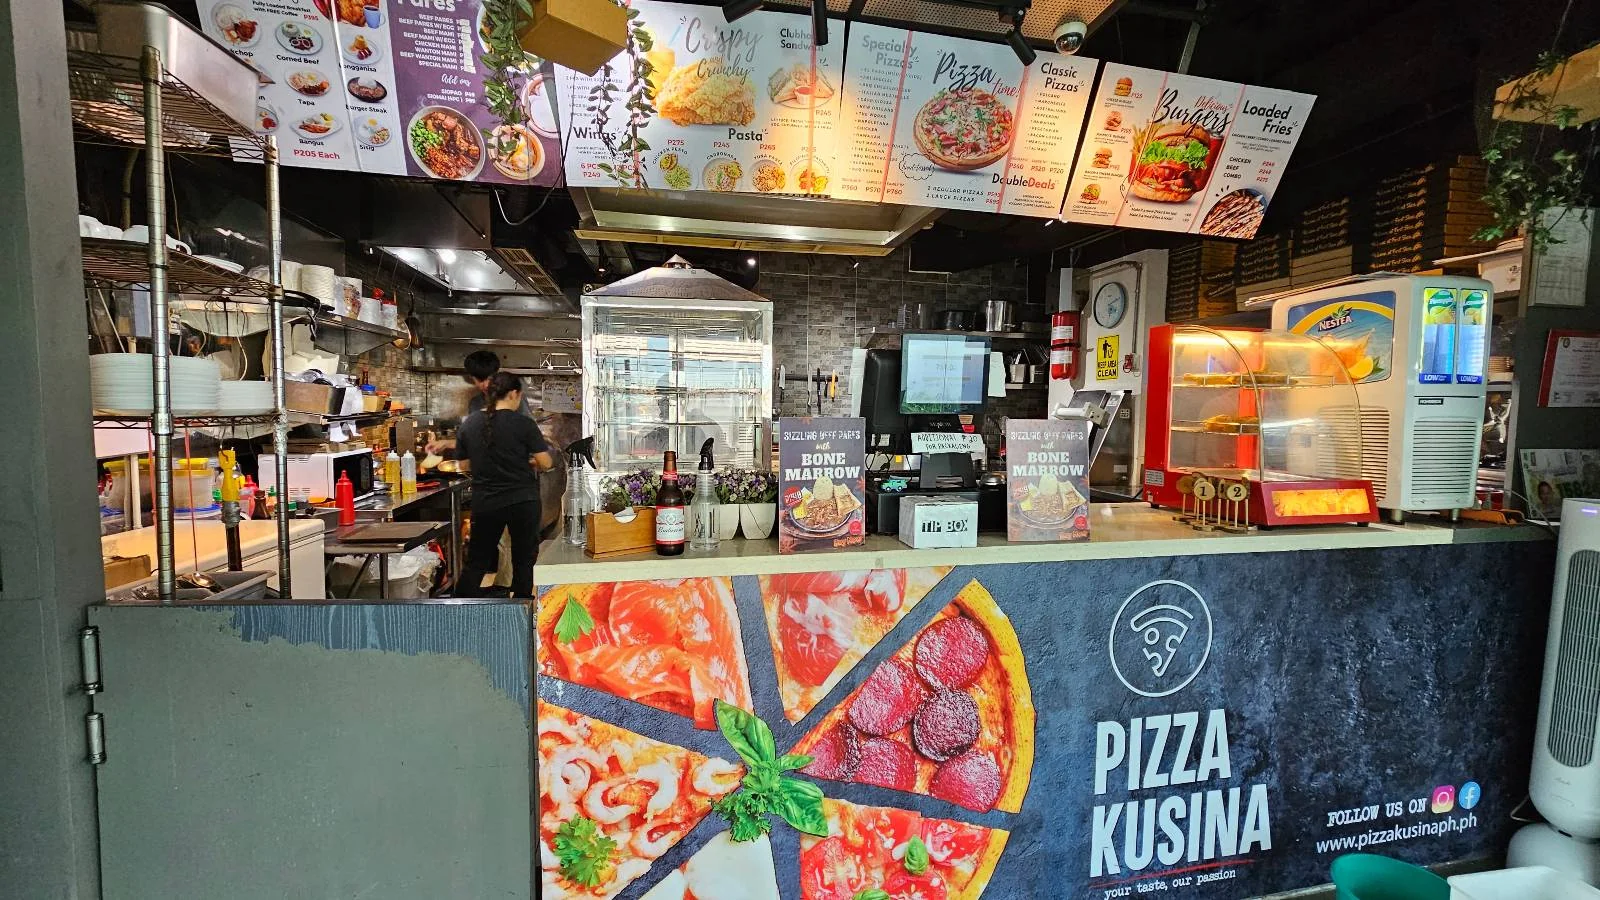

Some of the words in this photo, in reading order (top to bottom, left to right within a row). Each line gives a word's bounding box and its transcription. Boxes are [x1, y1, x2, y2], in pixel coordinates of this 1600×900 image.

[434, 16, 454, 24] PARES
[414, 40, 440, 48] CHICKEN
[440, 43, 457, 51] MAMI
[686, 16, 763, 62] Crispy
[414, 47, 441, 55] WANTON
[862, 35, 918, 57] Specialy
[276, 54, 302, 63] Corned
[303, 56, 319, 65] Beef
[419, 60, 442, 68] SPECIAL
[697, 53, 751, 84] Crunchy
[932, 51, 997, 93] Pizza
[1040, 62, 1078, 79] Classic
[441, 73, 459, 85] Add
[1045, 77, 1079, 93] Pizzas
[298, 98, 315, 106] Tapa
[1153, 88, 1231, 138] Burgers
[1242, 100, 1293, 120] Loaded
[1262, 119, 1293, 136] Fries
[728, 128, 763, 142] Pasta
[293, 149, 317, 158] P205
[318, 150, 341, 160] Each
[1229, 156, 1252, 164] CHICKEN
[1319, 315, 1352, 331] NESTEA
[1107, 360, 1117, 368] AREA
[1097, 369, 1117, 378] CLEAN
[784, 431, 817, 440] SIZZLING
[1011, 431, 1041, 440] SIZZLING
[802, 453, 845, 466] BONE
[1028, 452, 1069, 463] BONE
[785, 466, 860, 481] MARROW
[1013, 464, 1084, 477] MARROW
[1200, 486, 1207, 496] 1
[1233, 486, 1242, 497] 2
[922, 520, 942, 532] TIP
[946, 519, 968, 533] BOX
[1094, 708, 1232, 796] PIZZA
[1327, 804, 1380, 827] FOLLOW
[1385, 801, 1403, 818] US
[1408, 798, 1428, 814] ON
[1089, 783, 1272, 878] KUSINA
[1316, 812, 1477, 853] www.pizzakusinaph.ph
[1104, 886, 1132, 900] your
[1137, 879, 1168, 894] taste,
[1172, 876, 1192, 888] our
[1197, 869, 1236, 886] passion
